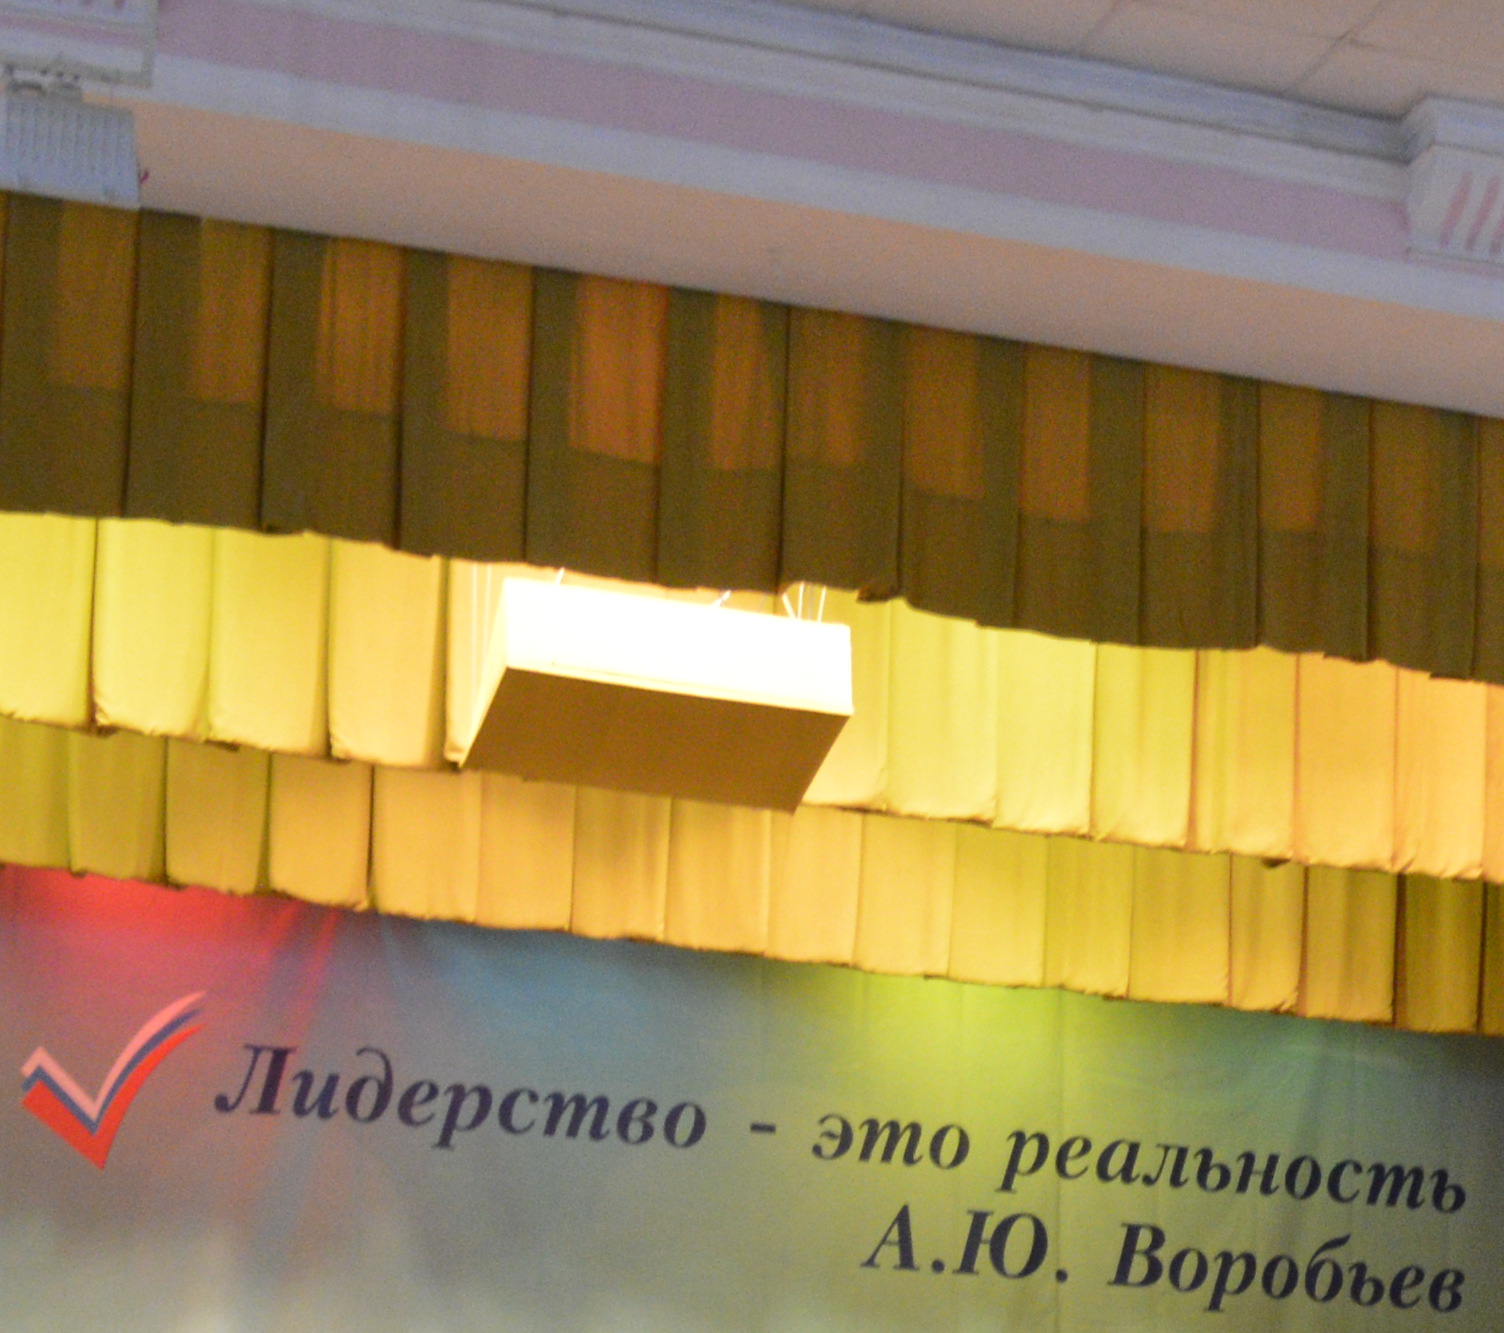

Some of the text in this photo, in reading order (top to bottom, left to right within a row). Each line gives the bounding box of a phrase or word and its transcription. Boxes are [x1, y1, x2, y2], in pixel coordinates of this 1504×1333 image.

[214, 1043, 708, 1150] Лидерство
[810, 1110, 973, 1170] это
[994, 1118, 1469, 1214] реальность
[860, 1202, 1466, 1314] А.Ю. Воробьев
